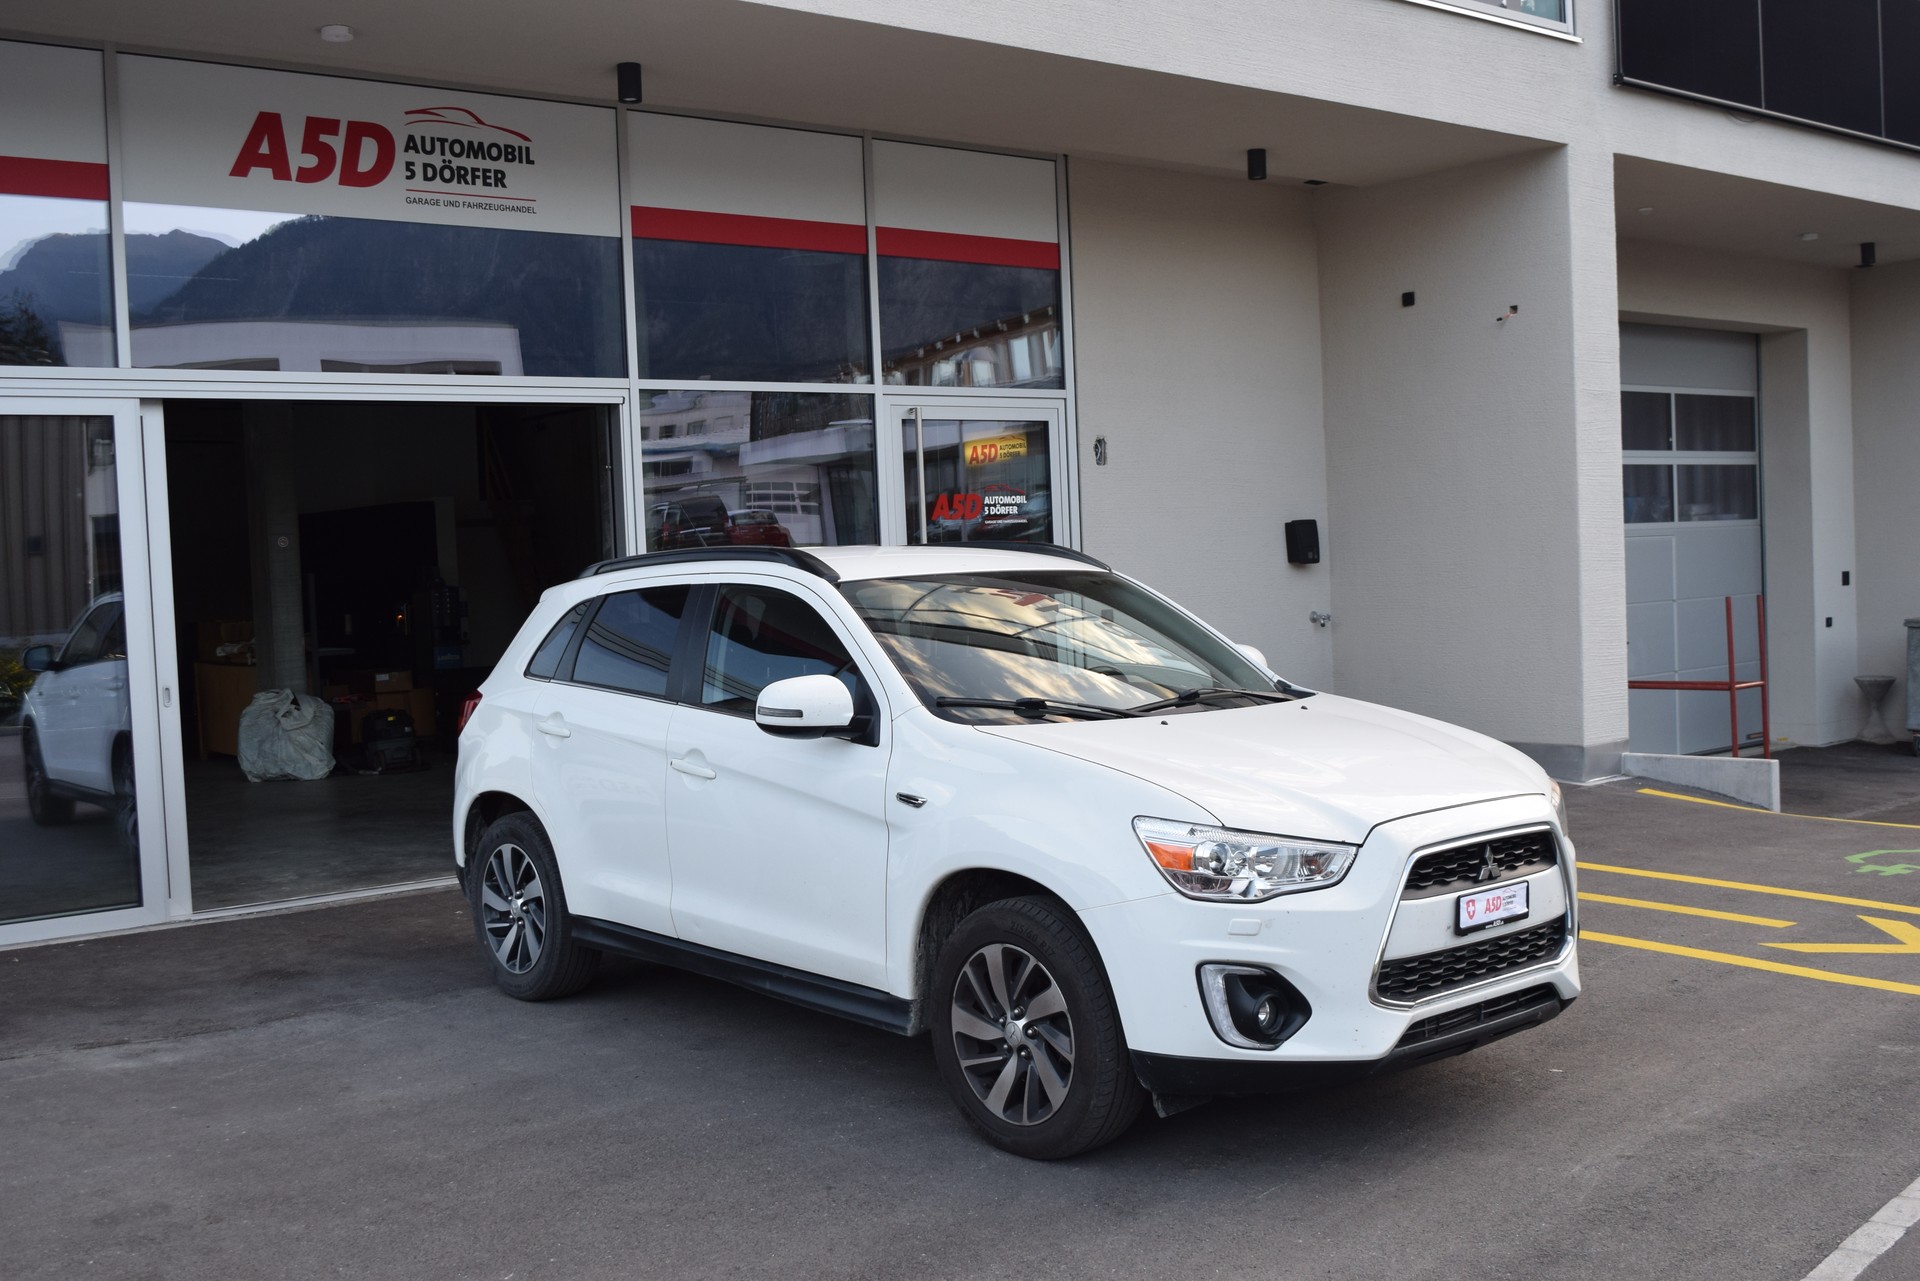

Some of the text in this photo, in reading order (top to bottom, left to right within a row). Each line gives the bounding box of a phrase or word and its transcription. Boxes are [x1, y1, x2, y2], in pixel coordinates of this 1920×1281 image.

[228, 110, 396, 188] A5D
[403, 134, 536, 165] AUTOMOBIL
[404, 158, 508, 189] 5 DÖRFER
[405, 196, 537, 214] GARAGE UND FAHRZEUGHANDEL
[969, 444, 998, 464] A5D
[931, 494, 982, 520] A5D
[984, 496, 1027, 504] AUTOMOBIL
[985, 504, 1018, 515] 5 DÖRFER
[1485, 896, 1502, 914] A5D
